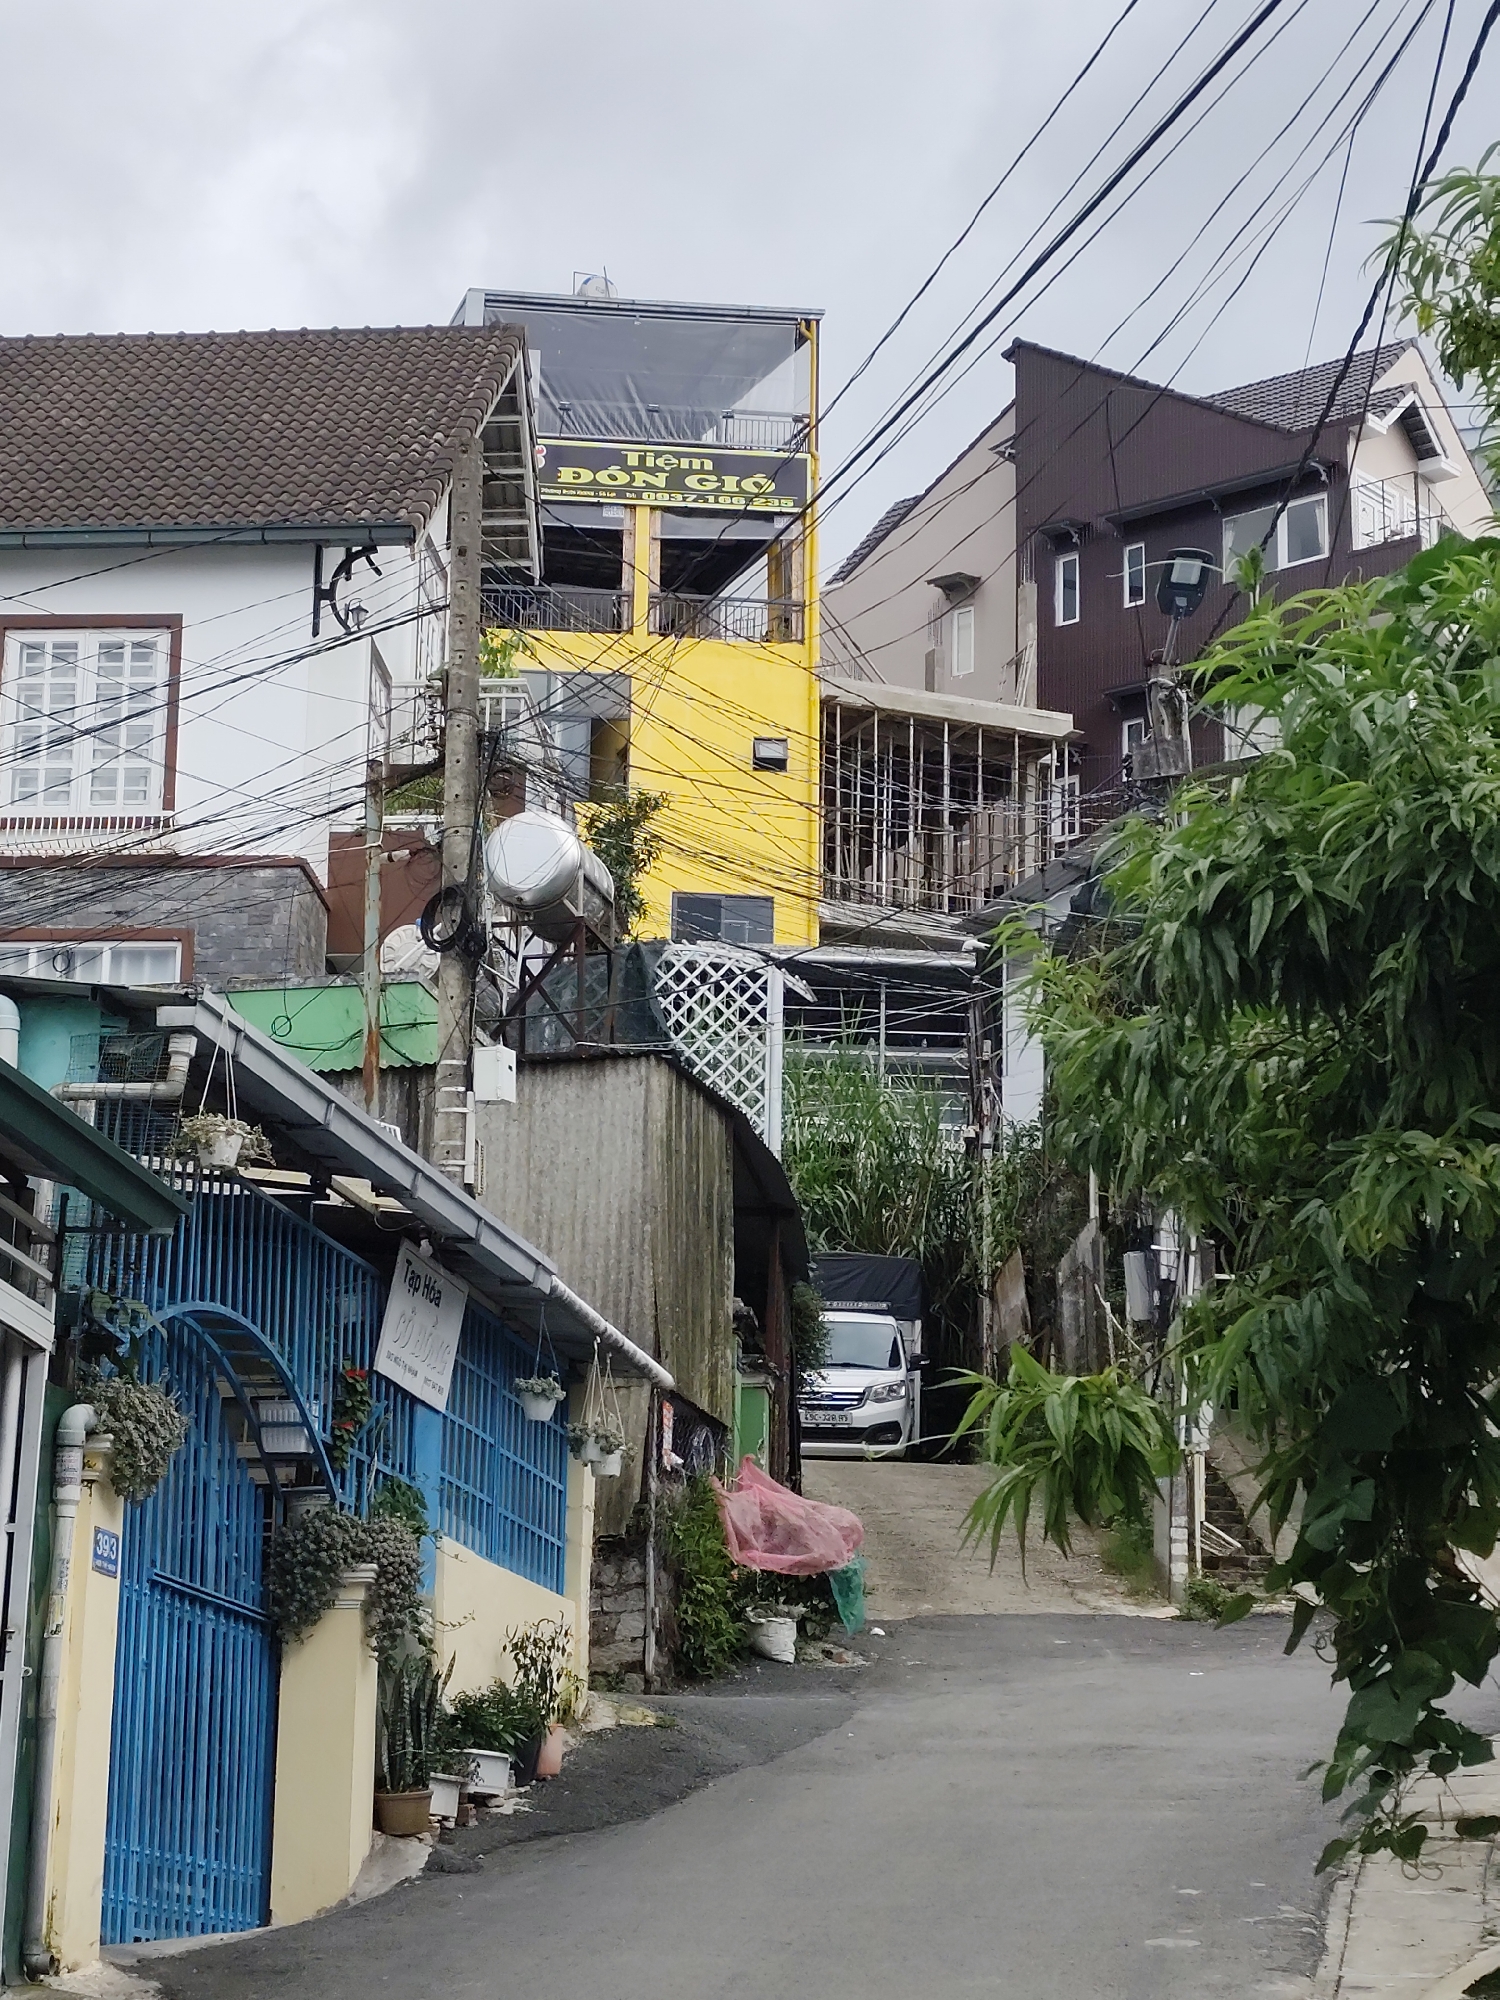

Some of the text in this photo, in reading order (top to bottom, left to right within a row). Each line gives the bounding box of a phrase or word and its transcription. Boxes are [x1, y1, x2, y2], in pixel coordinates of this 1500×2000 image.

[621, 450, 714, 471] Tiệm
[557, 465, 776, 493] ĐÓN GIÓ
[404, 1258, 442, 1308] Tạp Hóa
[96, 1532, 117, 1560] 393
